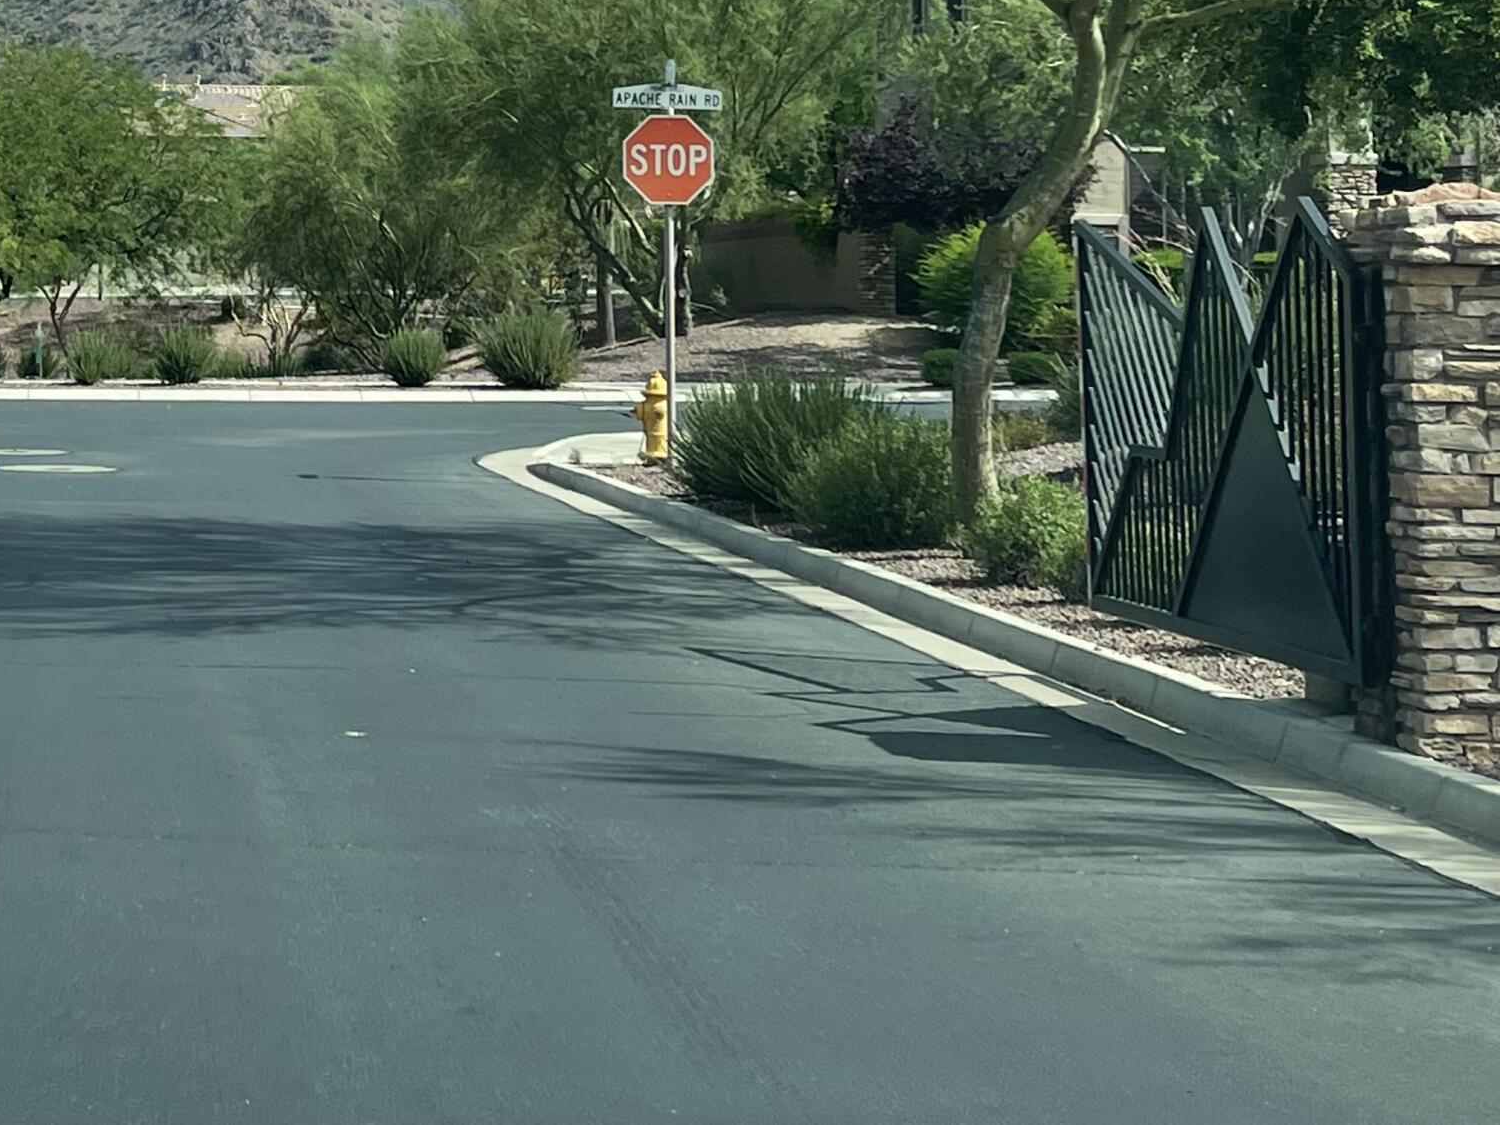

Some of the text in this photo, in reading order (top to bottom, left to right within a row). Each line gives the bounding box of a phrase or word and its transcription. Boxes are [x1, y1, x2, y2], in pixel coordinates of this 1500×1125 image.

[615, 92, 720, 107] APACHE RAIN RD
[630, 143, 707, 177] STOP
